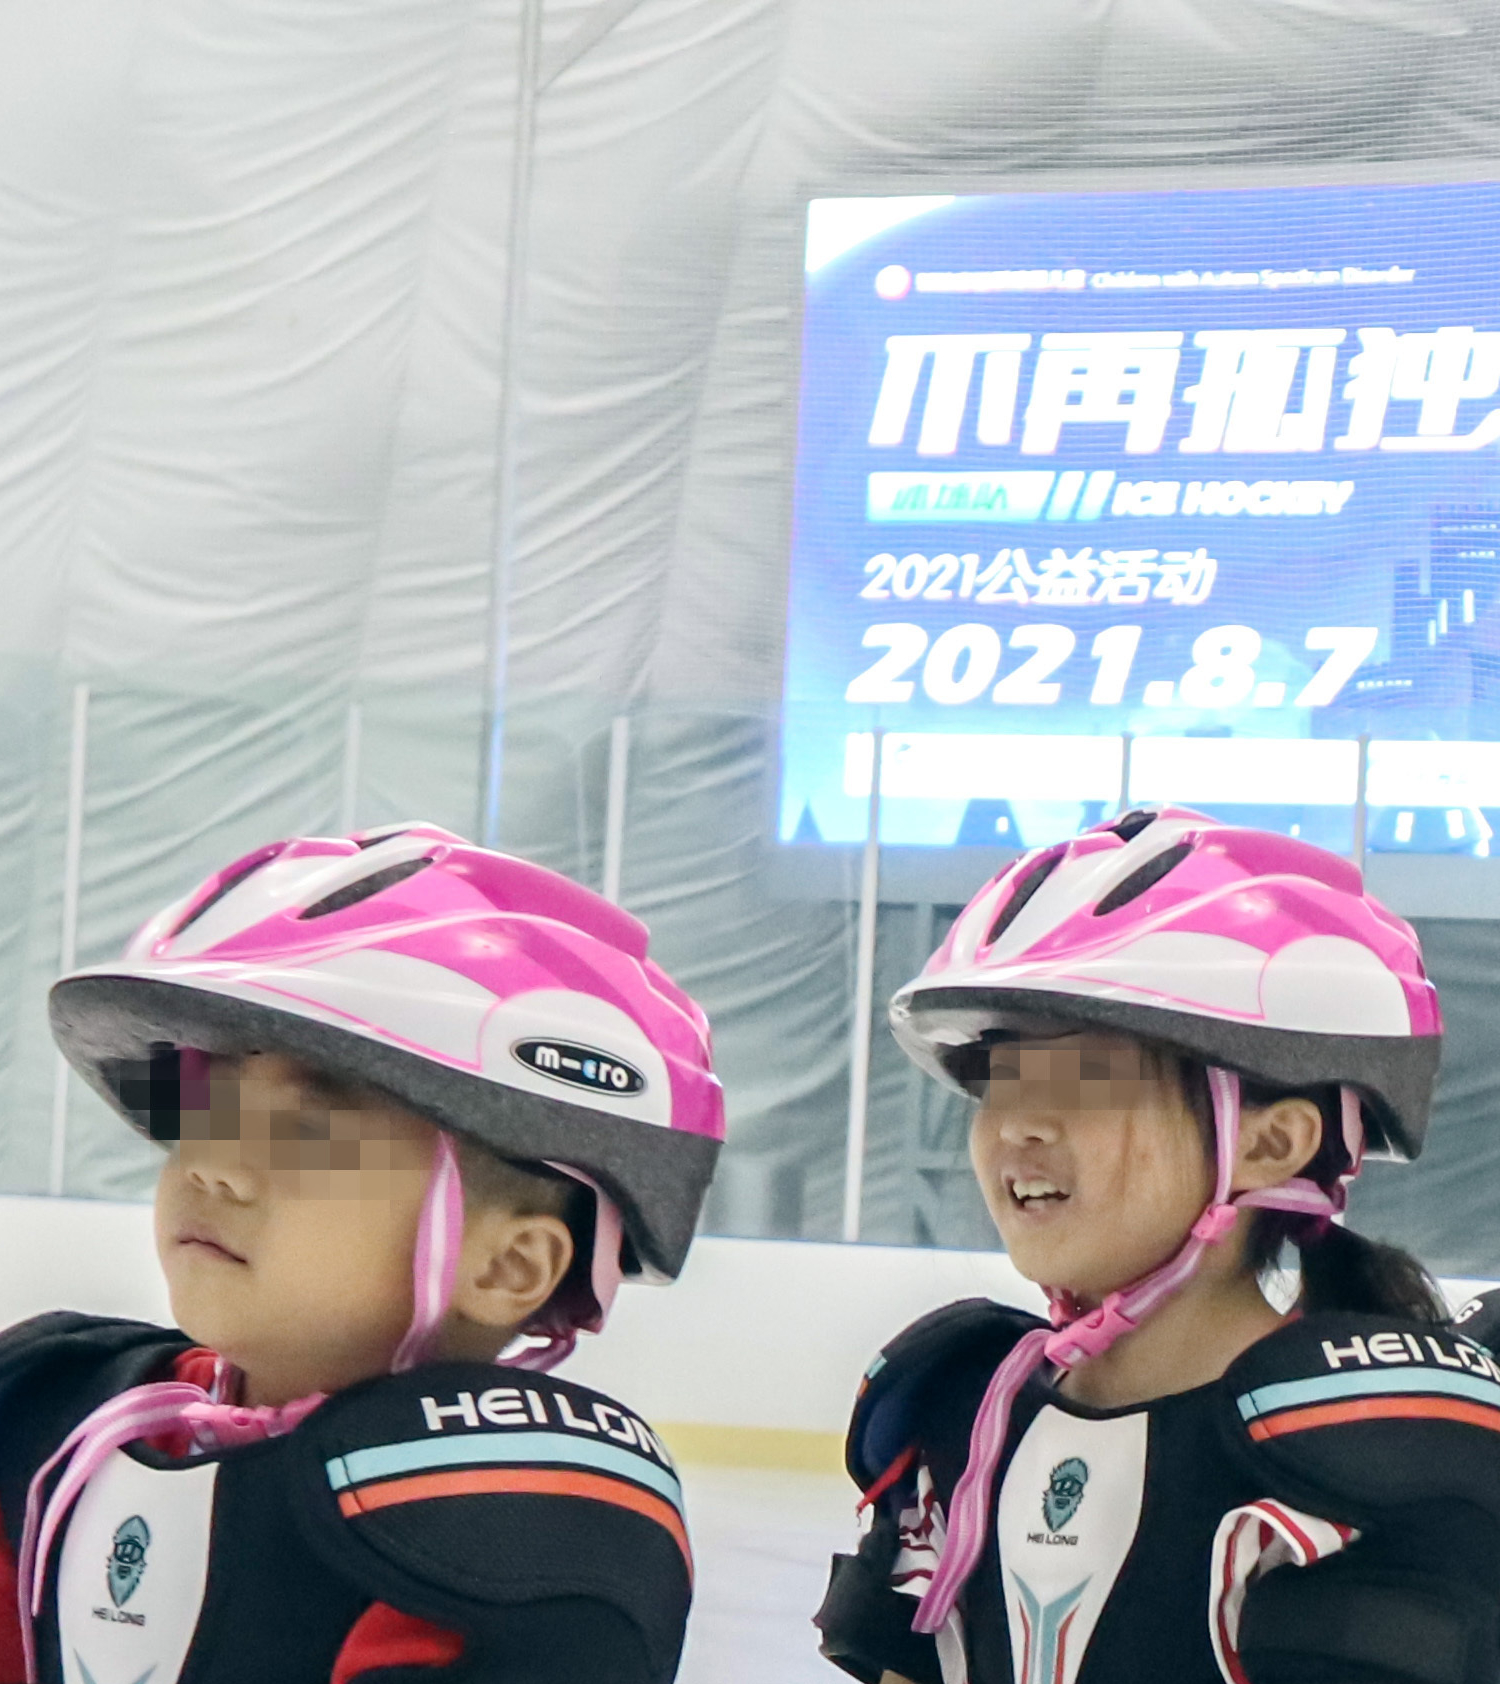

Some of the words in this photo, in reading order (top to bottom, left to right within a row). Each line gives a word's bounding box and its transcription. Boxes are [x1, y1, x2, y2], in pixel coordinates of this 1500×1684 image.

[1112, 480, 1181, 516] ICE
[1182, 480, 1356, 516] HOCKEY
[860, 547, 1219, 605] 2021公益活动
[844, 621, 1380, 708] 2021.8.7
[1320, 1332, 1424, 1369] HEI
[420, 1387, 549, 1431] HEI
